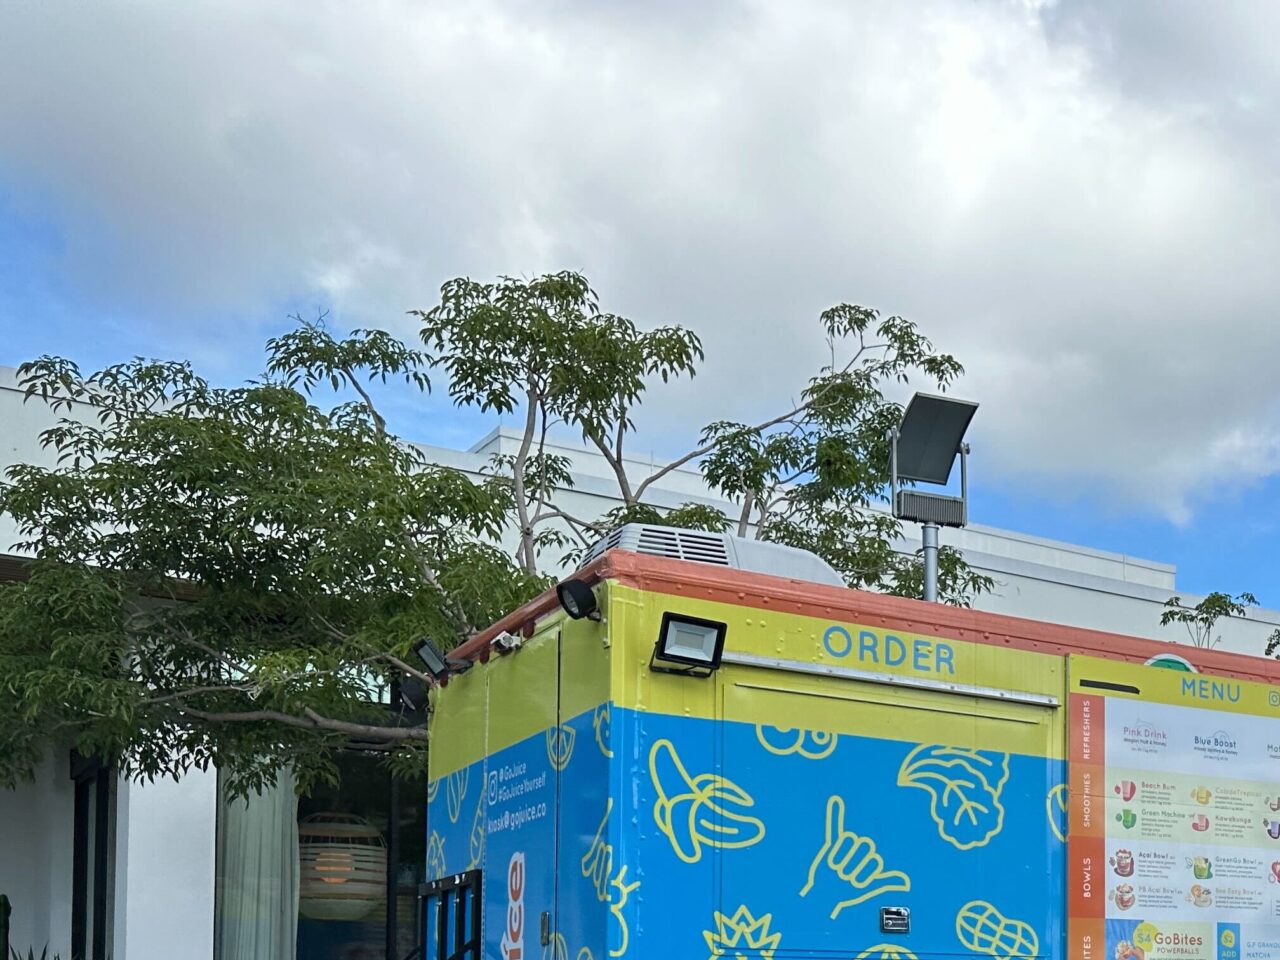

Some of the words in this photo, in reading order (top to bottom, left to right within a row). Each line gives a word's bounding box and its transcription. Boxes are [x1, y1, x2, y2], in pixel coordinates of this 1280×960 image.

[823, 625, 955, 674] ORDER
[1182, 677, 1240, 702] MENU
[1083, 700, 1091, 759] REFRESHERS
[1123, 726, 1142, 738] Pink
[1144, 728, 1167, 739] Drink
[1194, 736, 1211, 746] Blue
[1213, 738, 1237, 748] Boost
[1141, 781, 1160, 790] Beach
[1163, 783, 1176, 791] Bum
[1083, 773, 1091, 828] SMOOTHIES
[1161, 810, 1186, 819] Machine
[1083, 857, 1091, 898] BOWLS
[1154, 932, 1203, 946] GoBites
[1157, 947, 1200, 955] POWERBALLS
